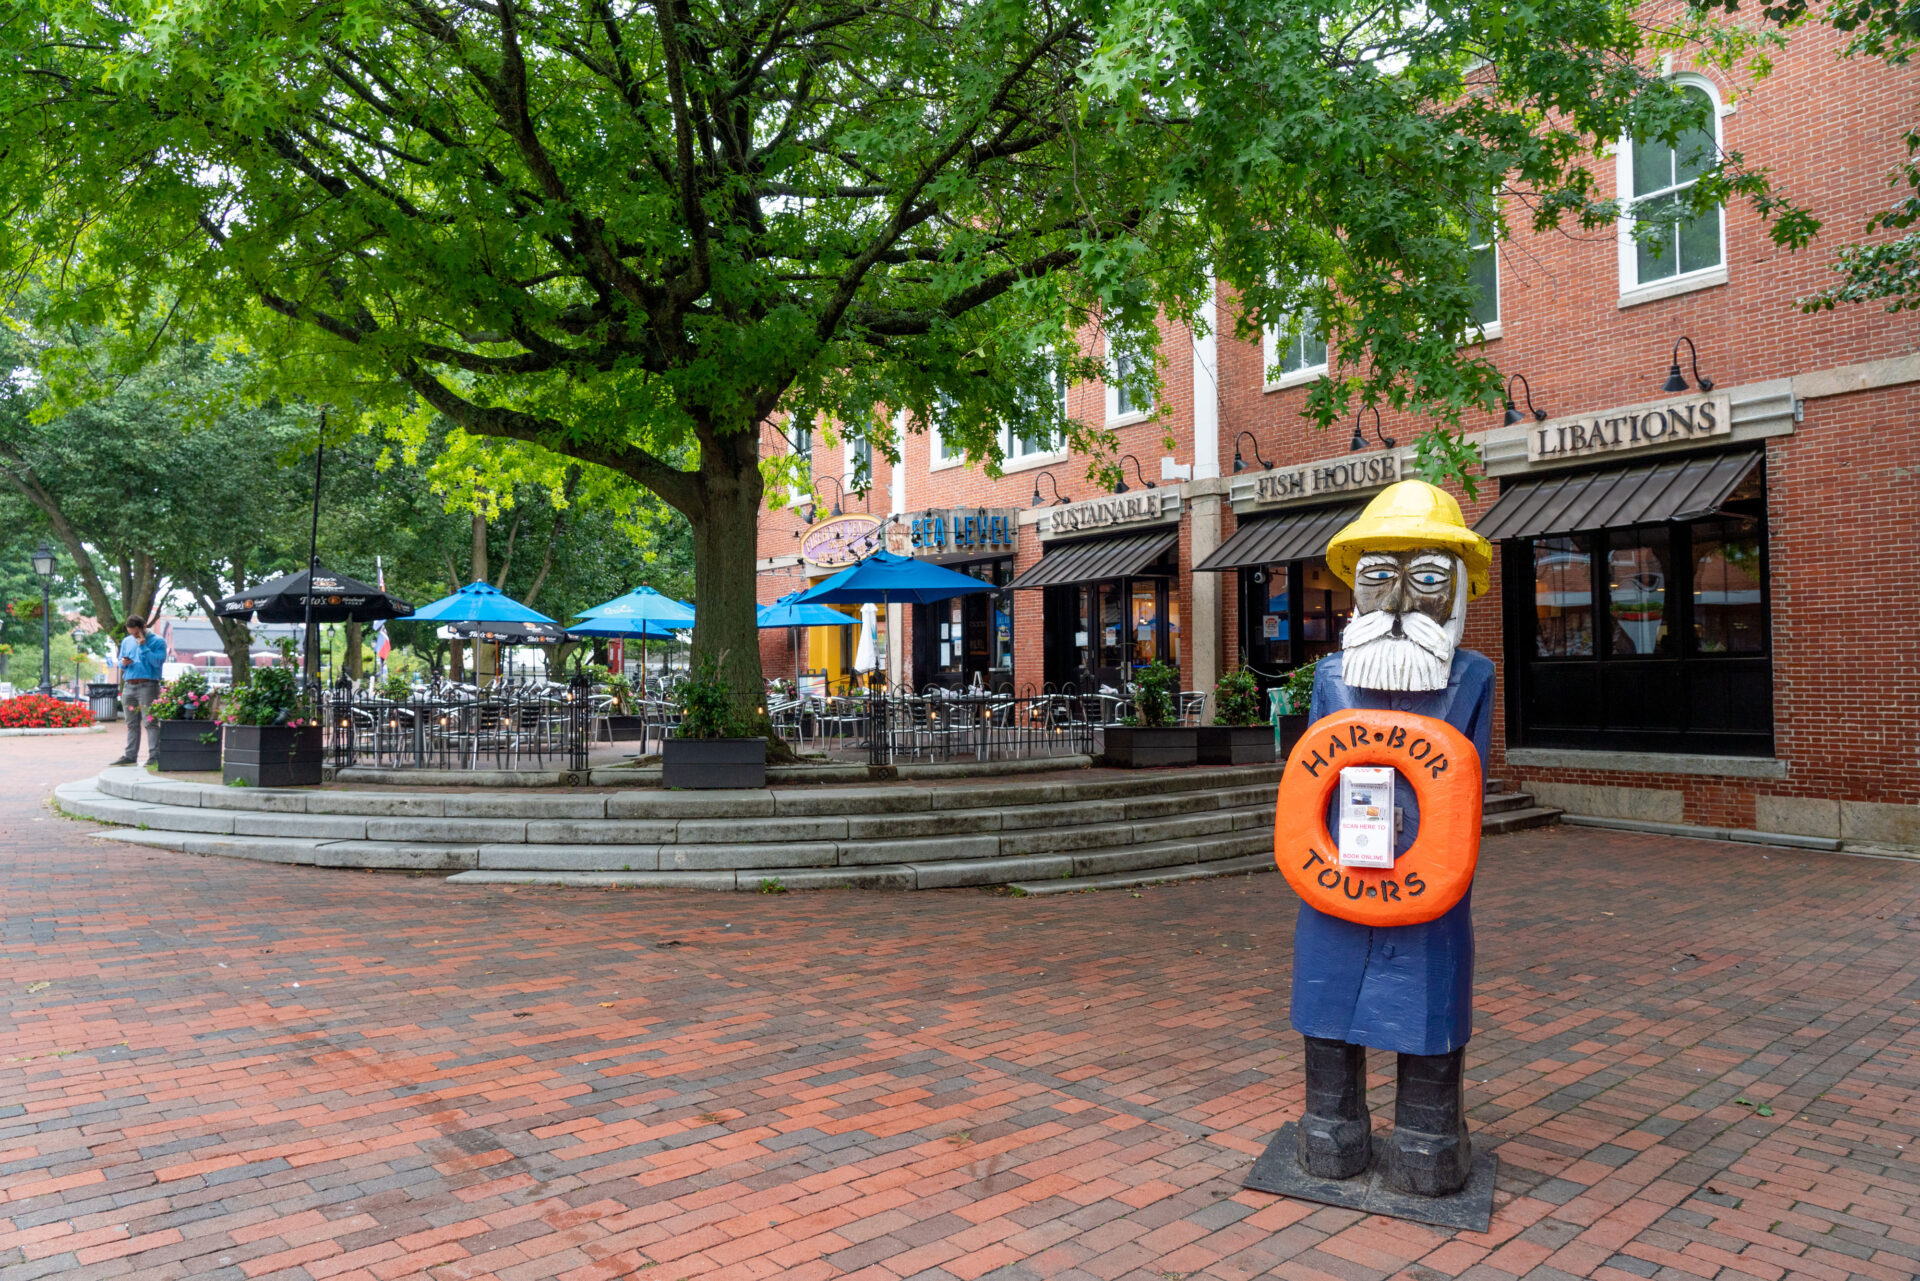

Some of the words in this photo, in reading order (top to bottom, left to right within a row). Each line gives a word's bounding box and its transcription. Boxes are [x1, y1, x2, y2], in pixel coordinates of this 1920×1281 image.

[1537, 401, 1717, 456] LIBATIONS
[1257, 471, 1306, 498] FISH
[1312, 456, 1397, 491] HOUSE
[911, 517, 946, 549] SEA
[954, 515, 1013, 545] LEVEL
[1051, 494, 1160, 530] SUSTAINABLE
[299, 596, 328, 606] Tto's
[1301, 725, 1449, 780] HARBOR
[1303, 849, 1426, 902] TOURS
